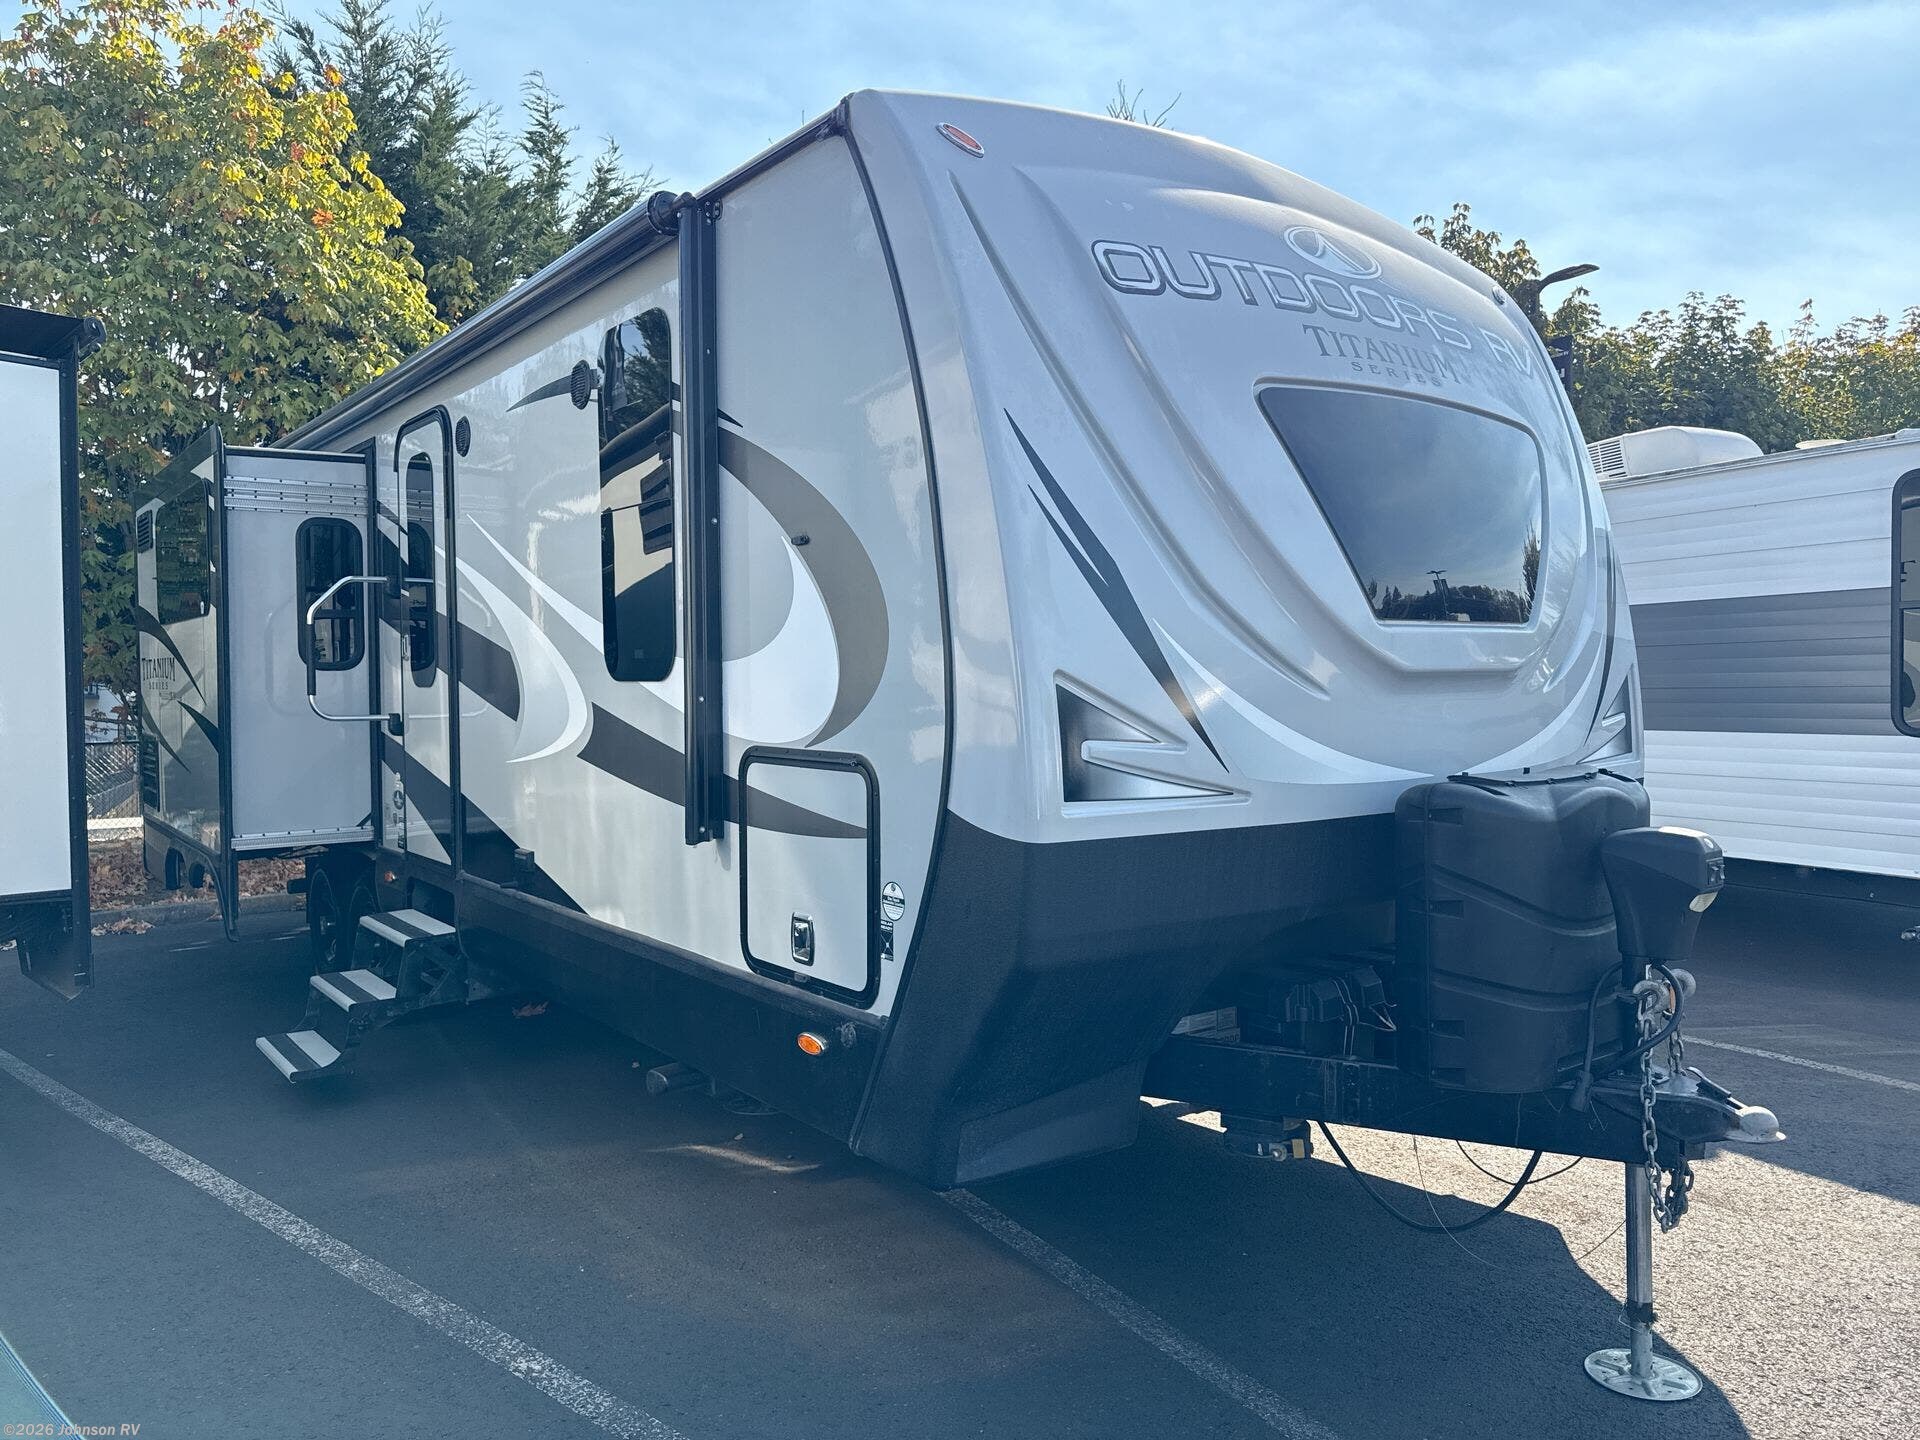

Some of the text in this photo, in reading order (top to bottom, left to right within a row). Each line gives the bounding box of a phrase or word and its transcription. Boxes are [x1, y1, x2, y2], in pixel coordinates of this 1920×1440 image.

[1091, 239, 1534, 376] OUTDOORS RV
[1302, 324, 1461, 384] TITANIUM
[1351, 361, 1441, 387] SERIES
[141, 657, 175, 682] TITANIUM
